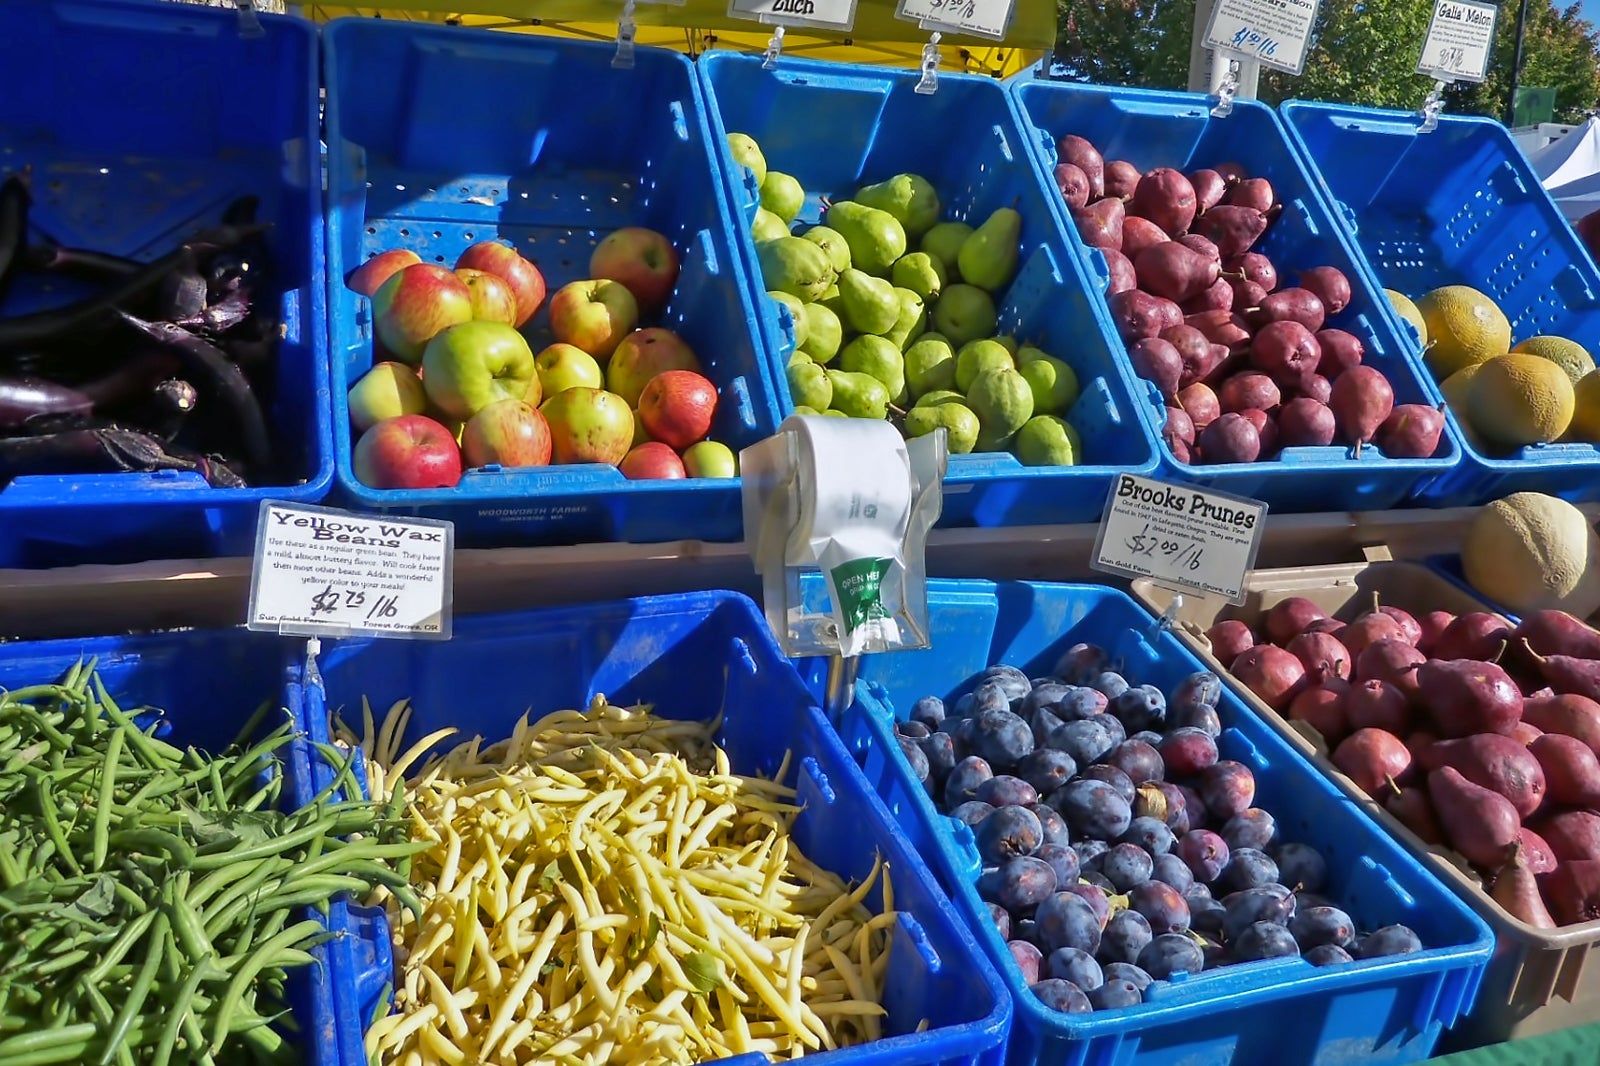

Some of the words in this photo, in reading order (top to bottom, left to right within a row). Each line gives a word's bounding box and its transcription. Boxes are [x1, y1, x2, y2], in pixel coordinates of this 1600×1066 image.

[1466, 9, 1492, 26] Melon
[551, 505, 587, 514] FARMS
[1118, 476, 1185, 511] Brooks
[1189, 495, 1255, 529] Prunes
[1122, 499, 1133, 507] One
[272, 511, 369, 534] Yellow
[379, 525, 441, 542] Wax
[312, 528, 400, 548] Beans
[1210, 530, 1224, 540] They
[269, 537, 283, 546] Use
[285, 540, 307, 549] these
[326, 545, 353, 554] regular
[355, 547, 377, 556] green
[402, 550, 421, 561] They
[295, 552, 321, 561] almost
[323, 554, 352, 566] buttery
[383, 559, 398, 568] Will
[400, 562, 417, 570] cook
[419, 564, 441, 572] faster
[1100, 556, 1114, 565] Sun
[1115, 560, 1132, 570] Gold
[1132, 564, 1152, 574] Farm
[273, 560, 292, 570] then
[293, 563, 314, 572] most
[315, 566, 337, 574] other
[367, 570, 387, 578] Adds
[395, 573, 434, 582] wonderful
[301, 576, 328, 585] yellow
[329, 579, 350, 587] color
[351, 580, 360, 588] to
[361, 581, 380, 590] your
[842, 575, 864, 589] OPEN
[1178, 576, 1201, 587] Forest
[258, 613, 277, 621] Sun
[363, 620, 392, 628] Forest
